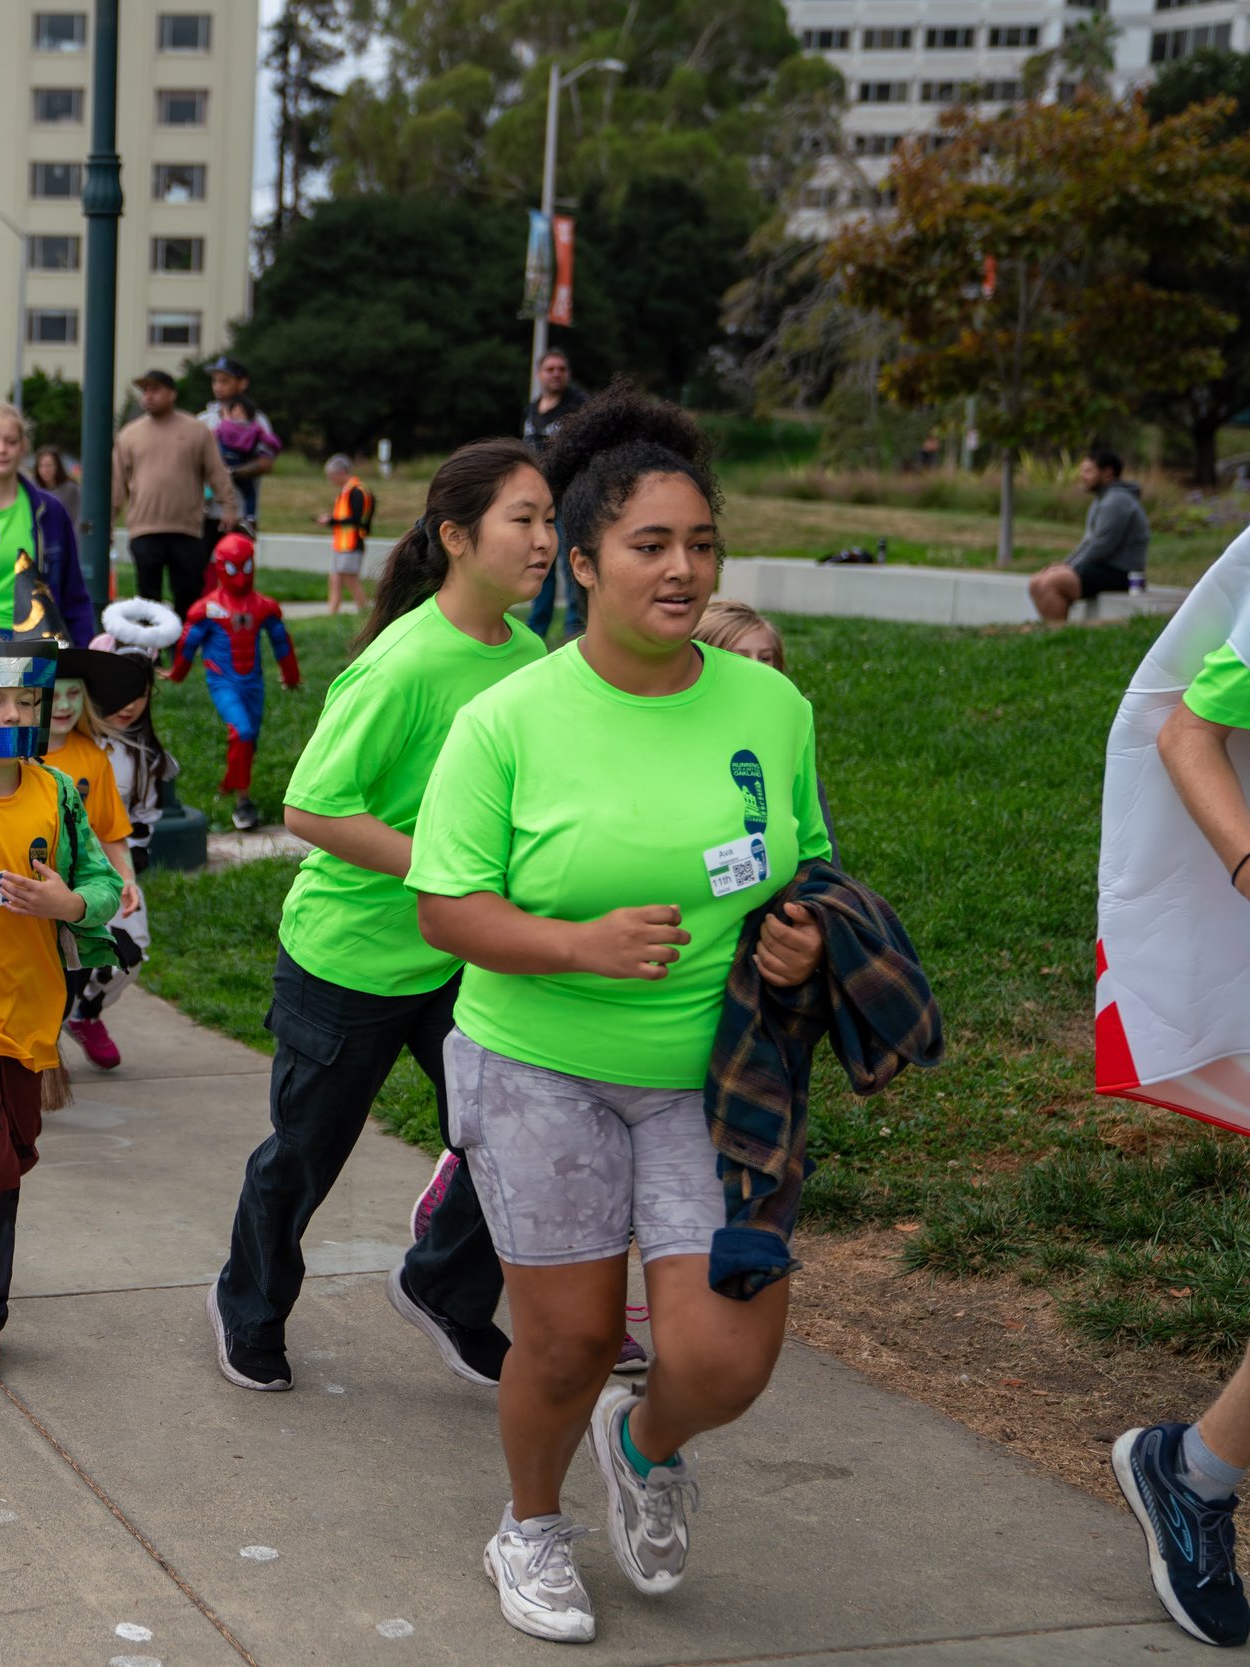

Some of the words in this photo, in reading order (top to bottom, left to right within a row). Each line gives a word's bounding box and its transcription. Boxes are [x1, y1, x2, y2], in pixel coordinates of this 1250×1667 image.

[733, 770, 762, 778] OAKLAND
[719, 849, 733, 858] Ava
[712, 875, 732, 887] 11th
